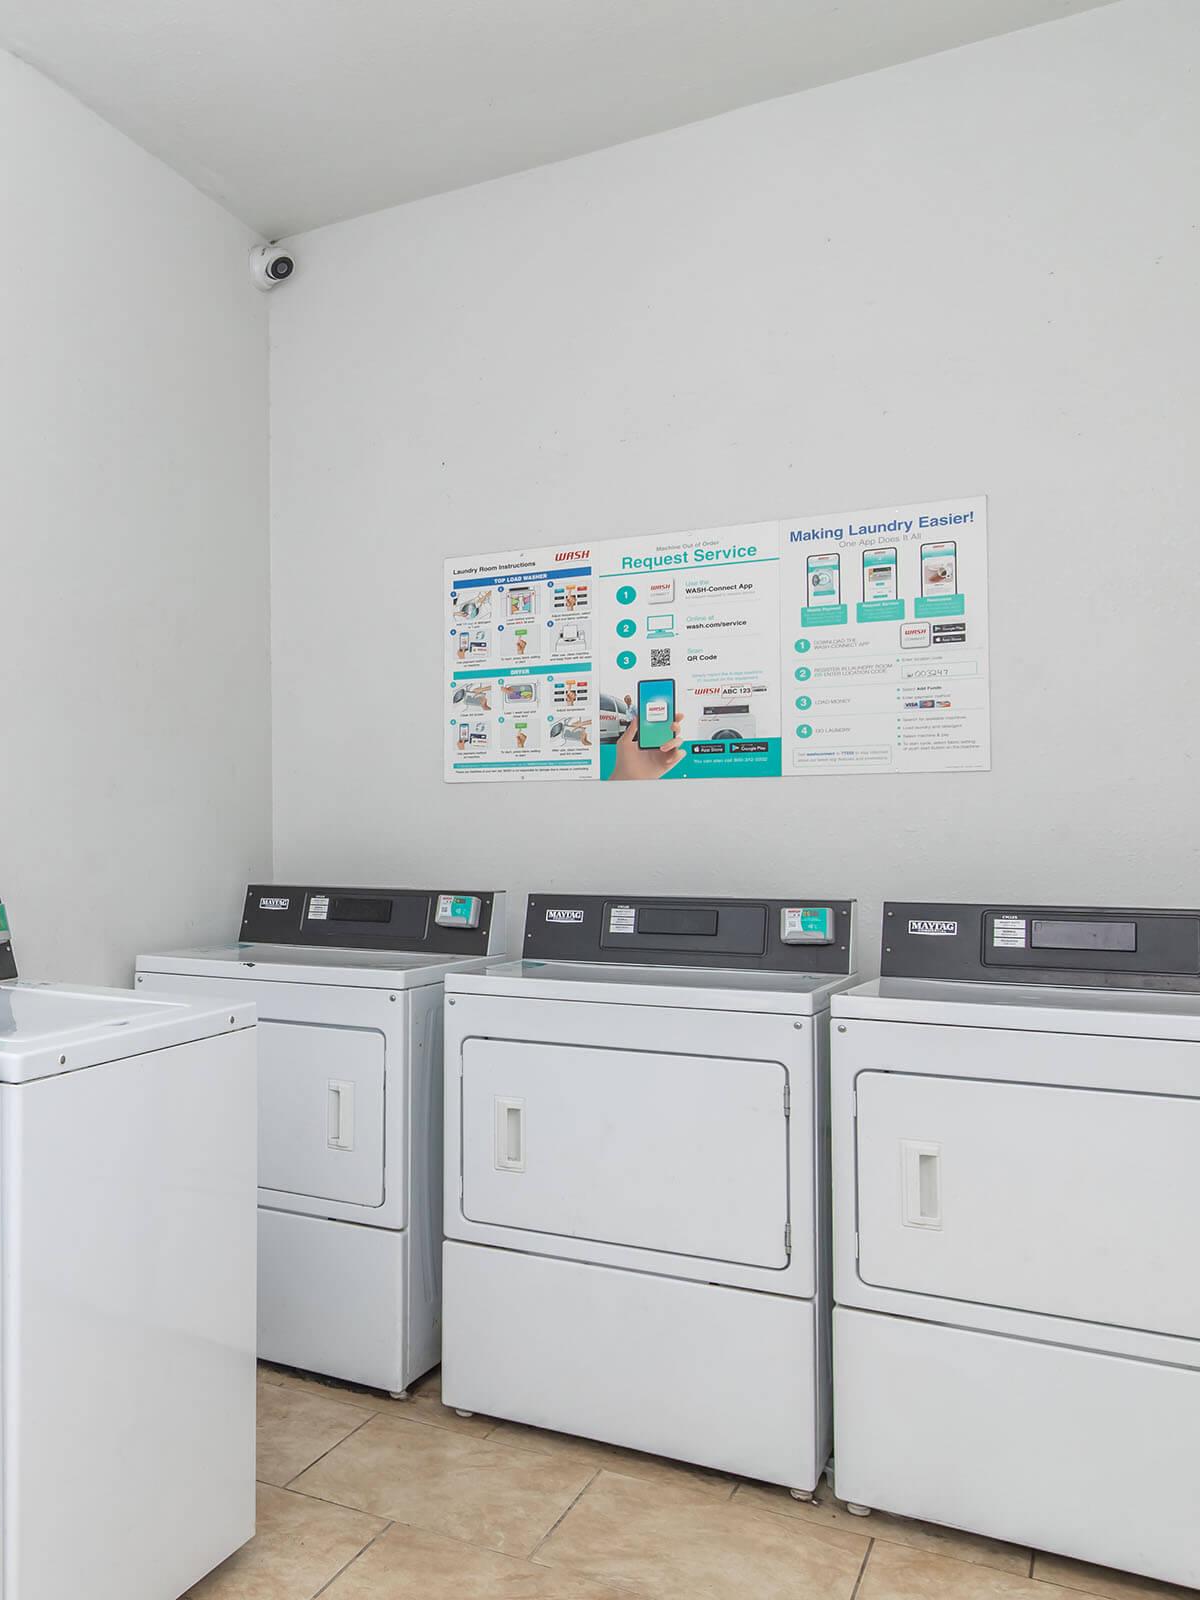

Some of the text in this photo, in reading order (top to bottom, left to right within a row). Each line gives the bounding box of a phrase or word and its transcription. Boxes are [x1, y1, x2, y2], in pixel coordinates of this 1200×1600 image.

[790, 511, 974, 543] Making Laundry Easier!
[859, 538, 875, 547] App
[879, 536, 900, 544] Does
[555, 550, 590, 562] WASH
[622, 545, 757, 570] Request Service
[453, 567, 478, 576] Laundry
[499, 561, 536, 570] Instructions
[523, 573, 547, 581] WASHER
[685, 583, 753, 595] WASH-Connect App
[686, 619, 747, 630] wash.com/service
[699, 654, 718, 662] Code
[510, 668, 530, 676] DRYER
[800, 669, 807, 678] 2
[694, 688, 721, 696] WASH
[800, 698, 807, 707] 3
[801, 727, 808, 735] 4
[548, 911, 581, 919] MAYTAG
[911, 921, 954, 931] MAYTAG
